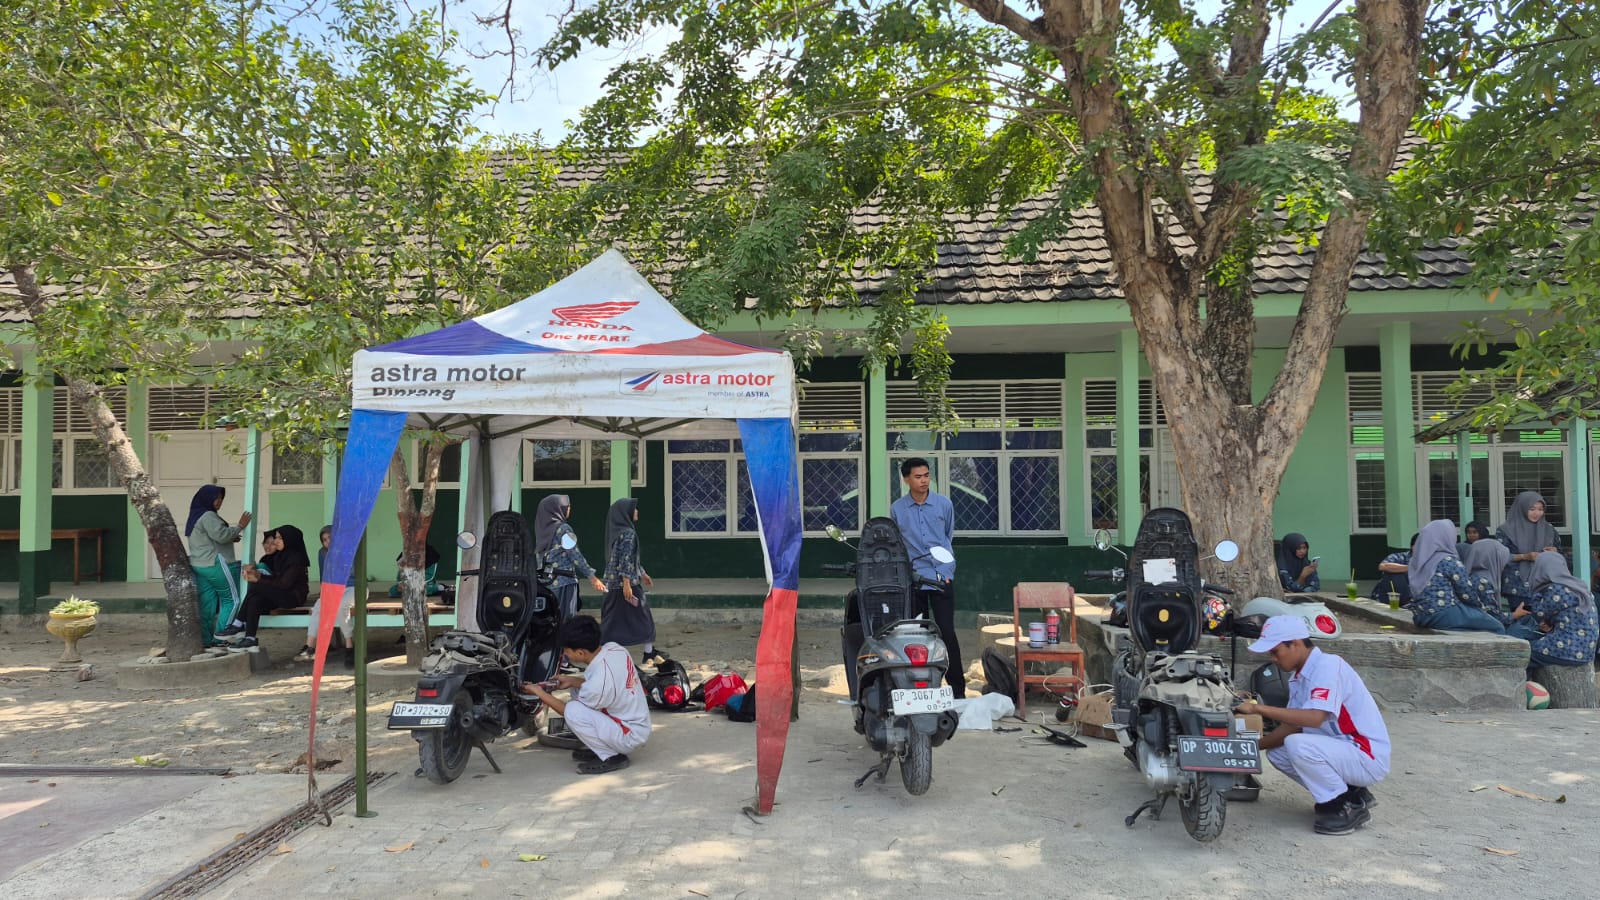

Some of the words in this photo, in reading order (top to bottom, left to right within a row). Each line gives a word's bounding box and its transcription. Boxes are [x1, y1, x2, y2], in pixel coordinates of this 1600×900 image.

[548, 319, 635, 331] HONDA
[541, 331, 573, 340] One
[370, 364, 437, 382] astra
[447, 364, 527, 382] motor
[662, 371, 711, 385] astra
[717, 371, 775, 386] motor
[893, 691, 905, 702] DP
[911, 690, 933, 701] 3067
[395, 705, 406, 715] DP
[1182, 740, 1197, 753] DP
[1204, 741, 1234, 755] 3004
[1240, 743, 1256, 756] SL
[1223, 758, 1256, 767] 05-27
